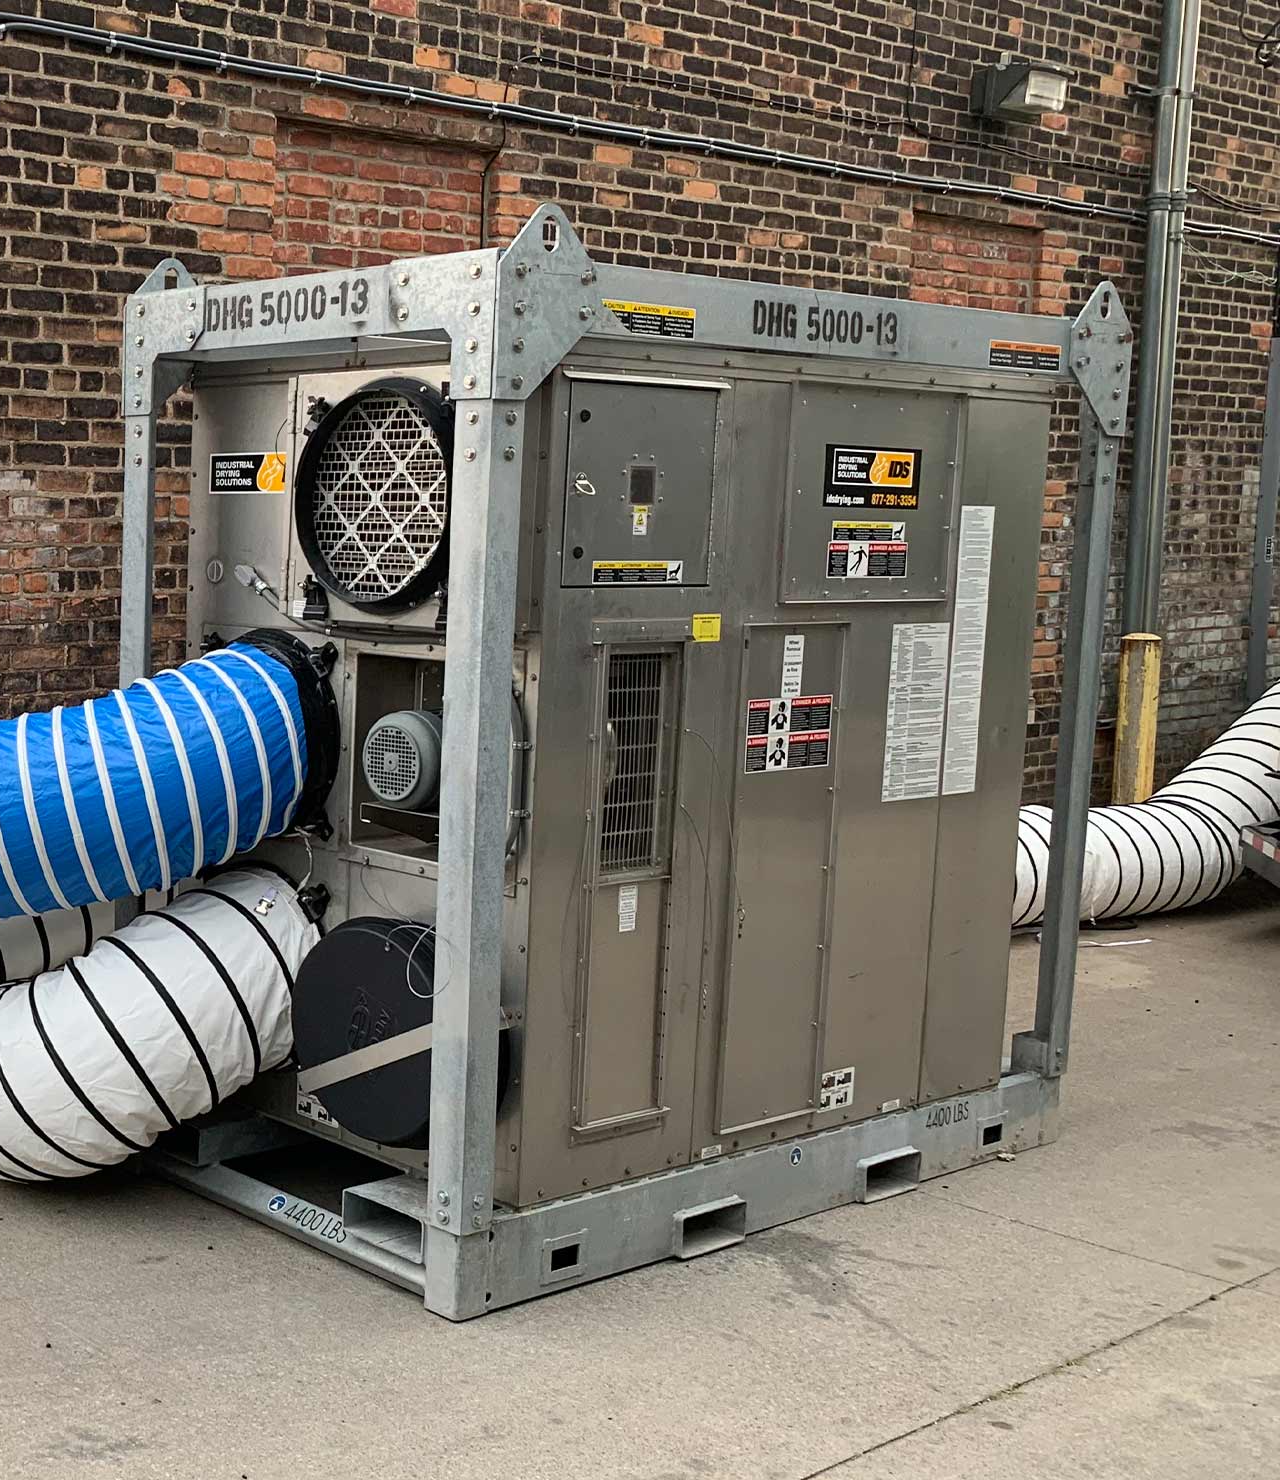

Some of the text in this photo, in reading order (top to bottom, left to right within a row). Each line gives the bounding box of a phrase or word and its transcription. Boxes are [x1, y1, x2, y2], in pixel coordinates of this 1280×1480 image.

[207, 278, 369, 332] DHG 5000-13
[753, 300, 898, 345] DHG 5000-13
[215, 461, 255, 469] INDUSTRIAL
[838, 456, 869, 464] INDUSTRIAL
[837, 463, 858, 471] DRYING
[888, 460, 911, 479] IDS
[215, 470, 241, 478] DRYING
[837, 470, 867, 479] SOLUTIONS
[215, 478, 253, 487] SOLUTIONS
[826, 493, 865, 506] idsdrying.com
[926, 1101, 969, 1128] 4400 LBS
[283, 1202, 325, 1231] 4400
